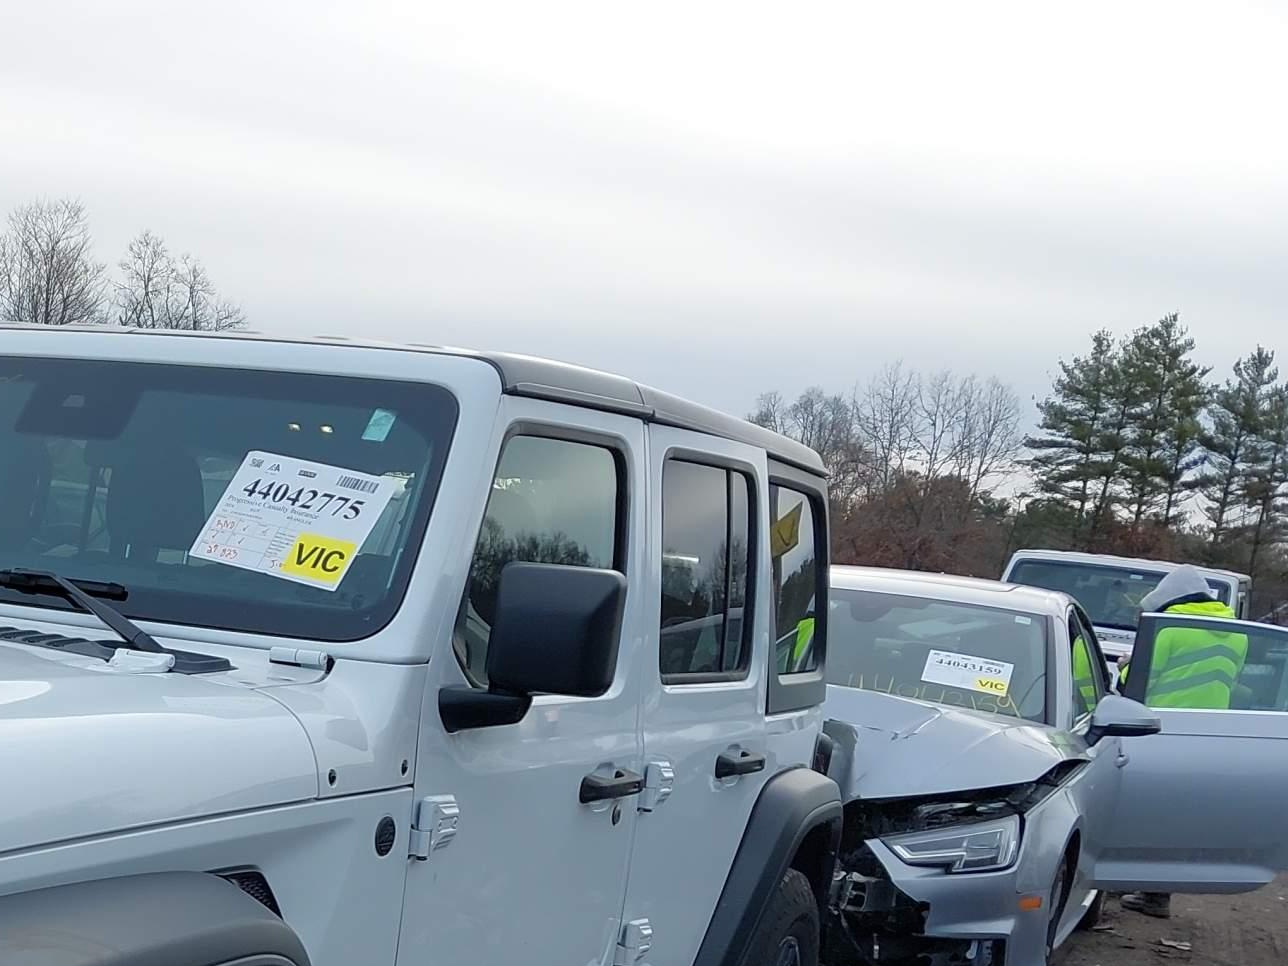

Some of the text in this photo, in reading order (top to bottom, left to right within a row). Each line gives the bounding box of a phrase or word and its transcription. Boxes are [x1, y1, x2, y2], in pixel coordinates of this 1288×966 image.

[243, 479, 366, 519] 44042775
[296, 542, 345, 573] VIC
[978, 679, 1005, 691] VIC
